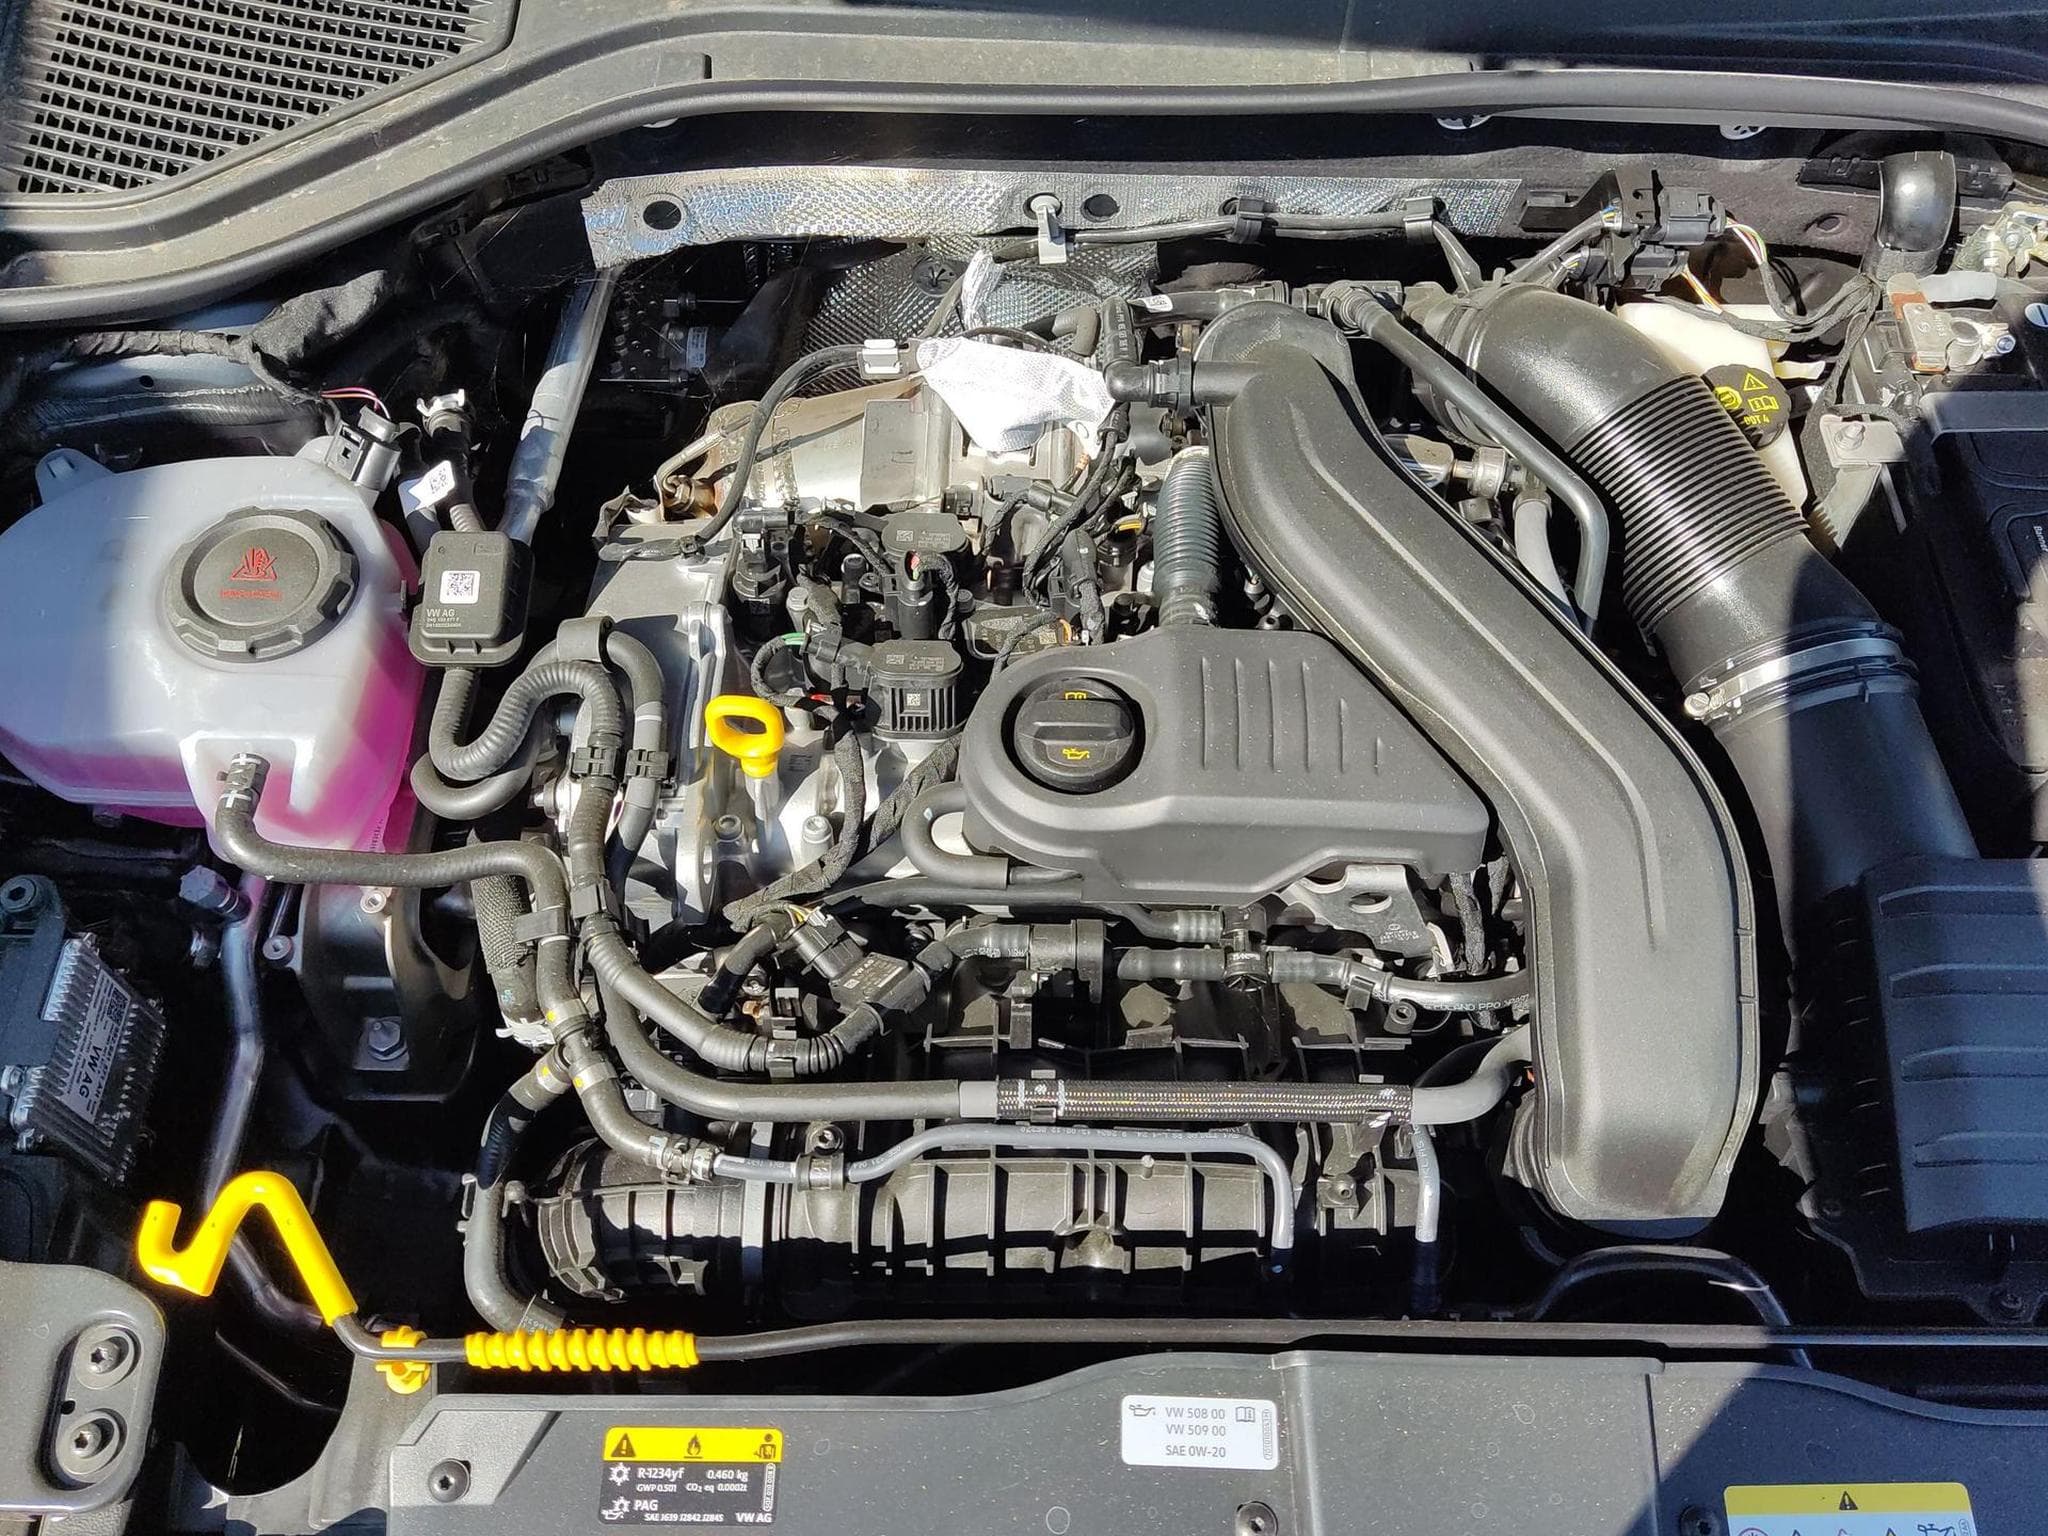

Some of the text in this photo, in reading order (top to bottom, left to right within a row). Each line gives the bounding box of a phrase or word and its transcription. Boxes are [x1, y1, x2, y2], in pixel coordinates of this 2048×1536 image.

[1743, 414, 1770, 425] DOT 4
[426, 608, 456, 618] VW AG
[88, 1046, 102, 1073] VW
[79, 1071, 93, 1098] AG
[1165, 1407, 1226, 1420] VW 508 00
[1165, 1424, 1226, 1437] VW 509 00
[1165, 1445, 1226, 1458] SAE 0W-20
[637, 1467, 749, 1482] R-1234yf 0.460 kg
[636, 1483, 657, 1492] GWP
[704, 1484, 715, 1494] eq
[633, 1499, 659, 1511] PAG
[643, 1512, 659, 1521] SAE
[735, 1512, 755, 1523] VW
[755, 1513, 773, 1523] AG
